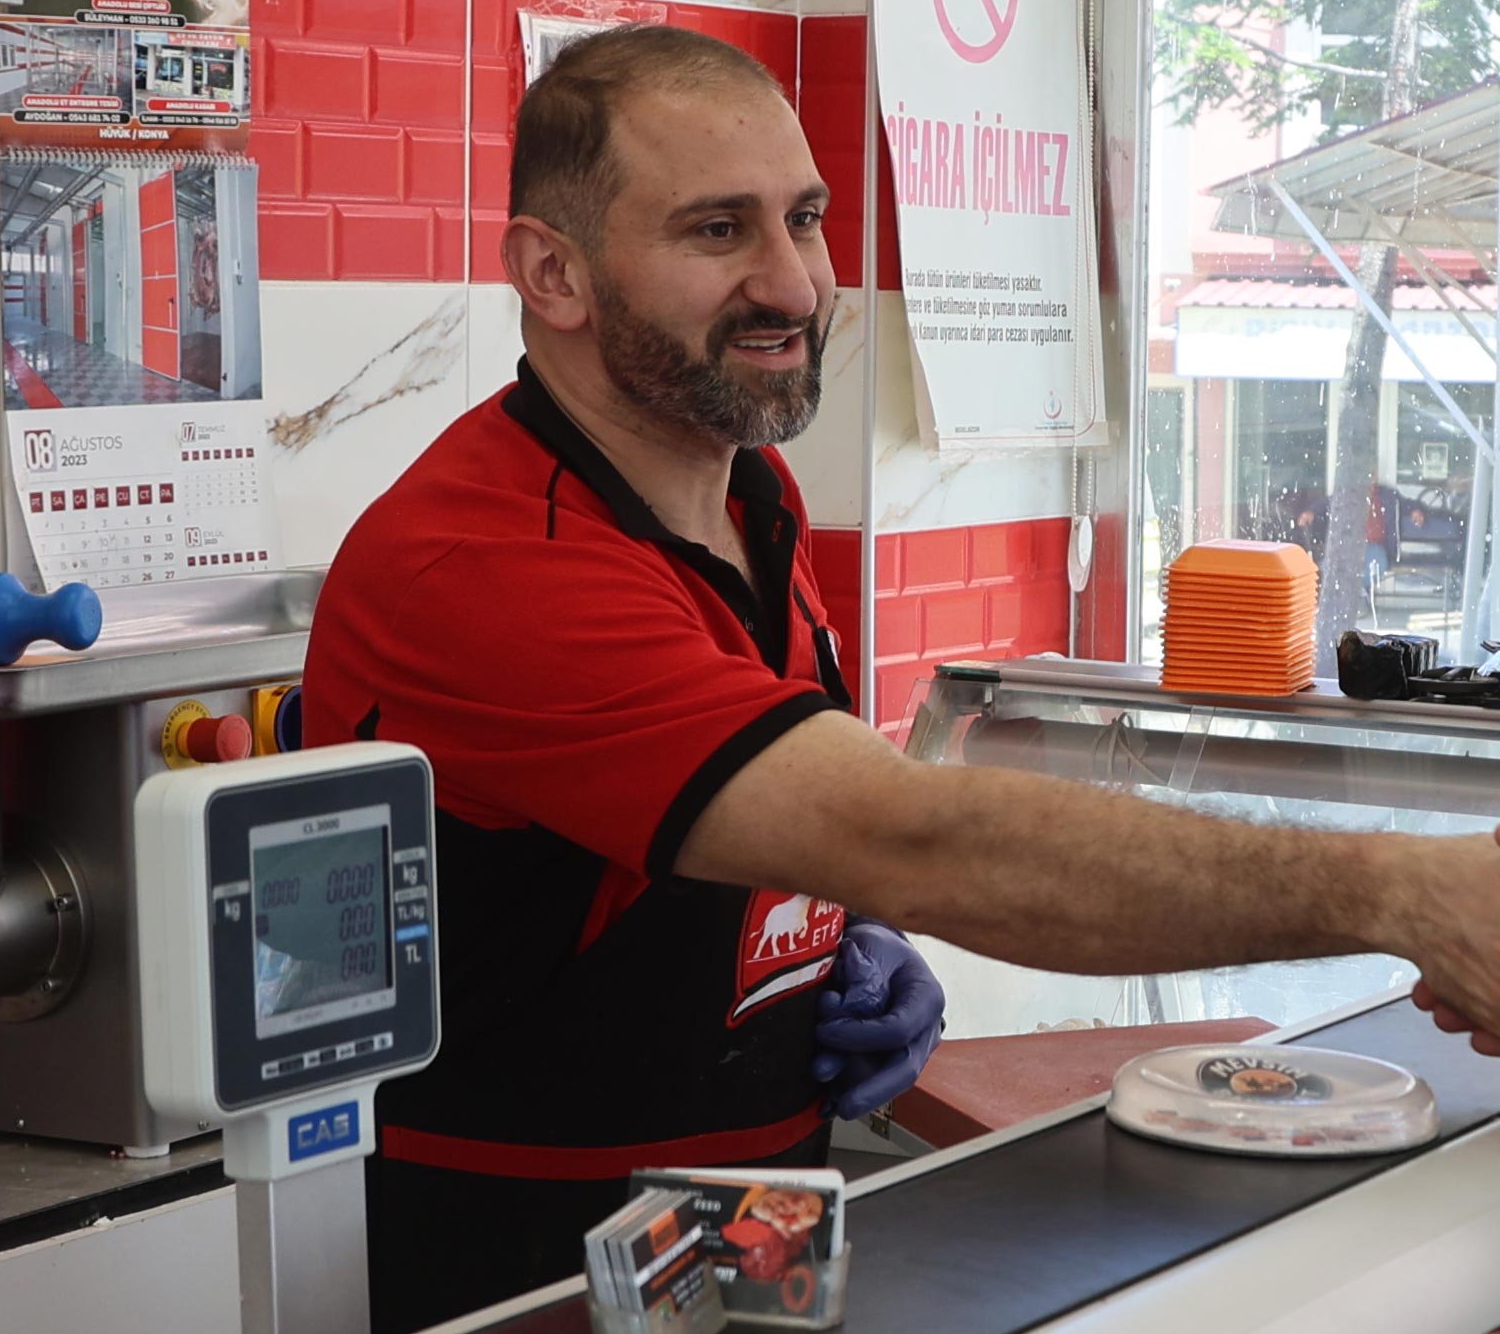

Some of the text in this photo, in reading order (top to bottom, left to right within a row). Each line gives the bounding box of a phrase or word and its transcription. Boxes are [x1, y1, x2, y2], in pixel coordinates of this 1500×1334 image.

[887, 102, 1071, 226] SİGARA İÇİLMEZ
[978, 299, 1068, 320] göz yuman sorumlulara
[987, 328, 1004, 346] para
[1005, 327, 1029, 343] cezası
[1030, 325, 1075, 347] uygulanır.
[25, 431, 53, 470] 08
[59, 435, 124, 453] AĞUSTOS
[61, 454, 88, 467] 2023
[402, 864, 419, 885] kg
[223, 899, 241, 922] kg
[404, 943, 423, 965] TL
[296, 1112, 351, 1150] CAS
